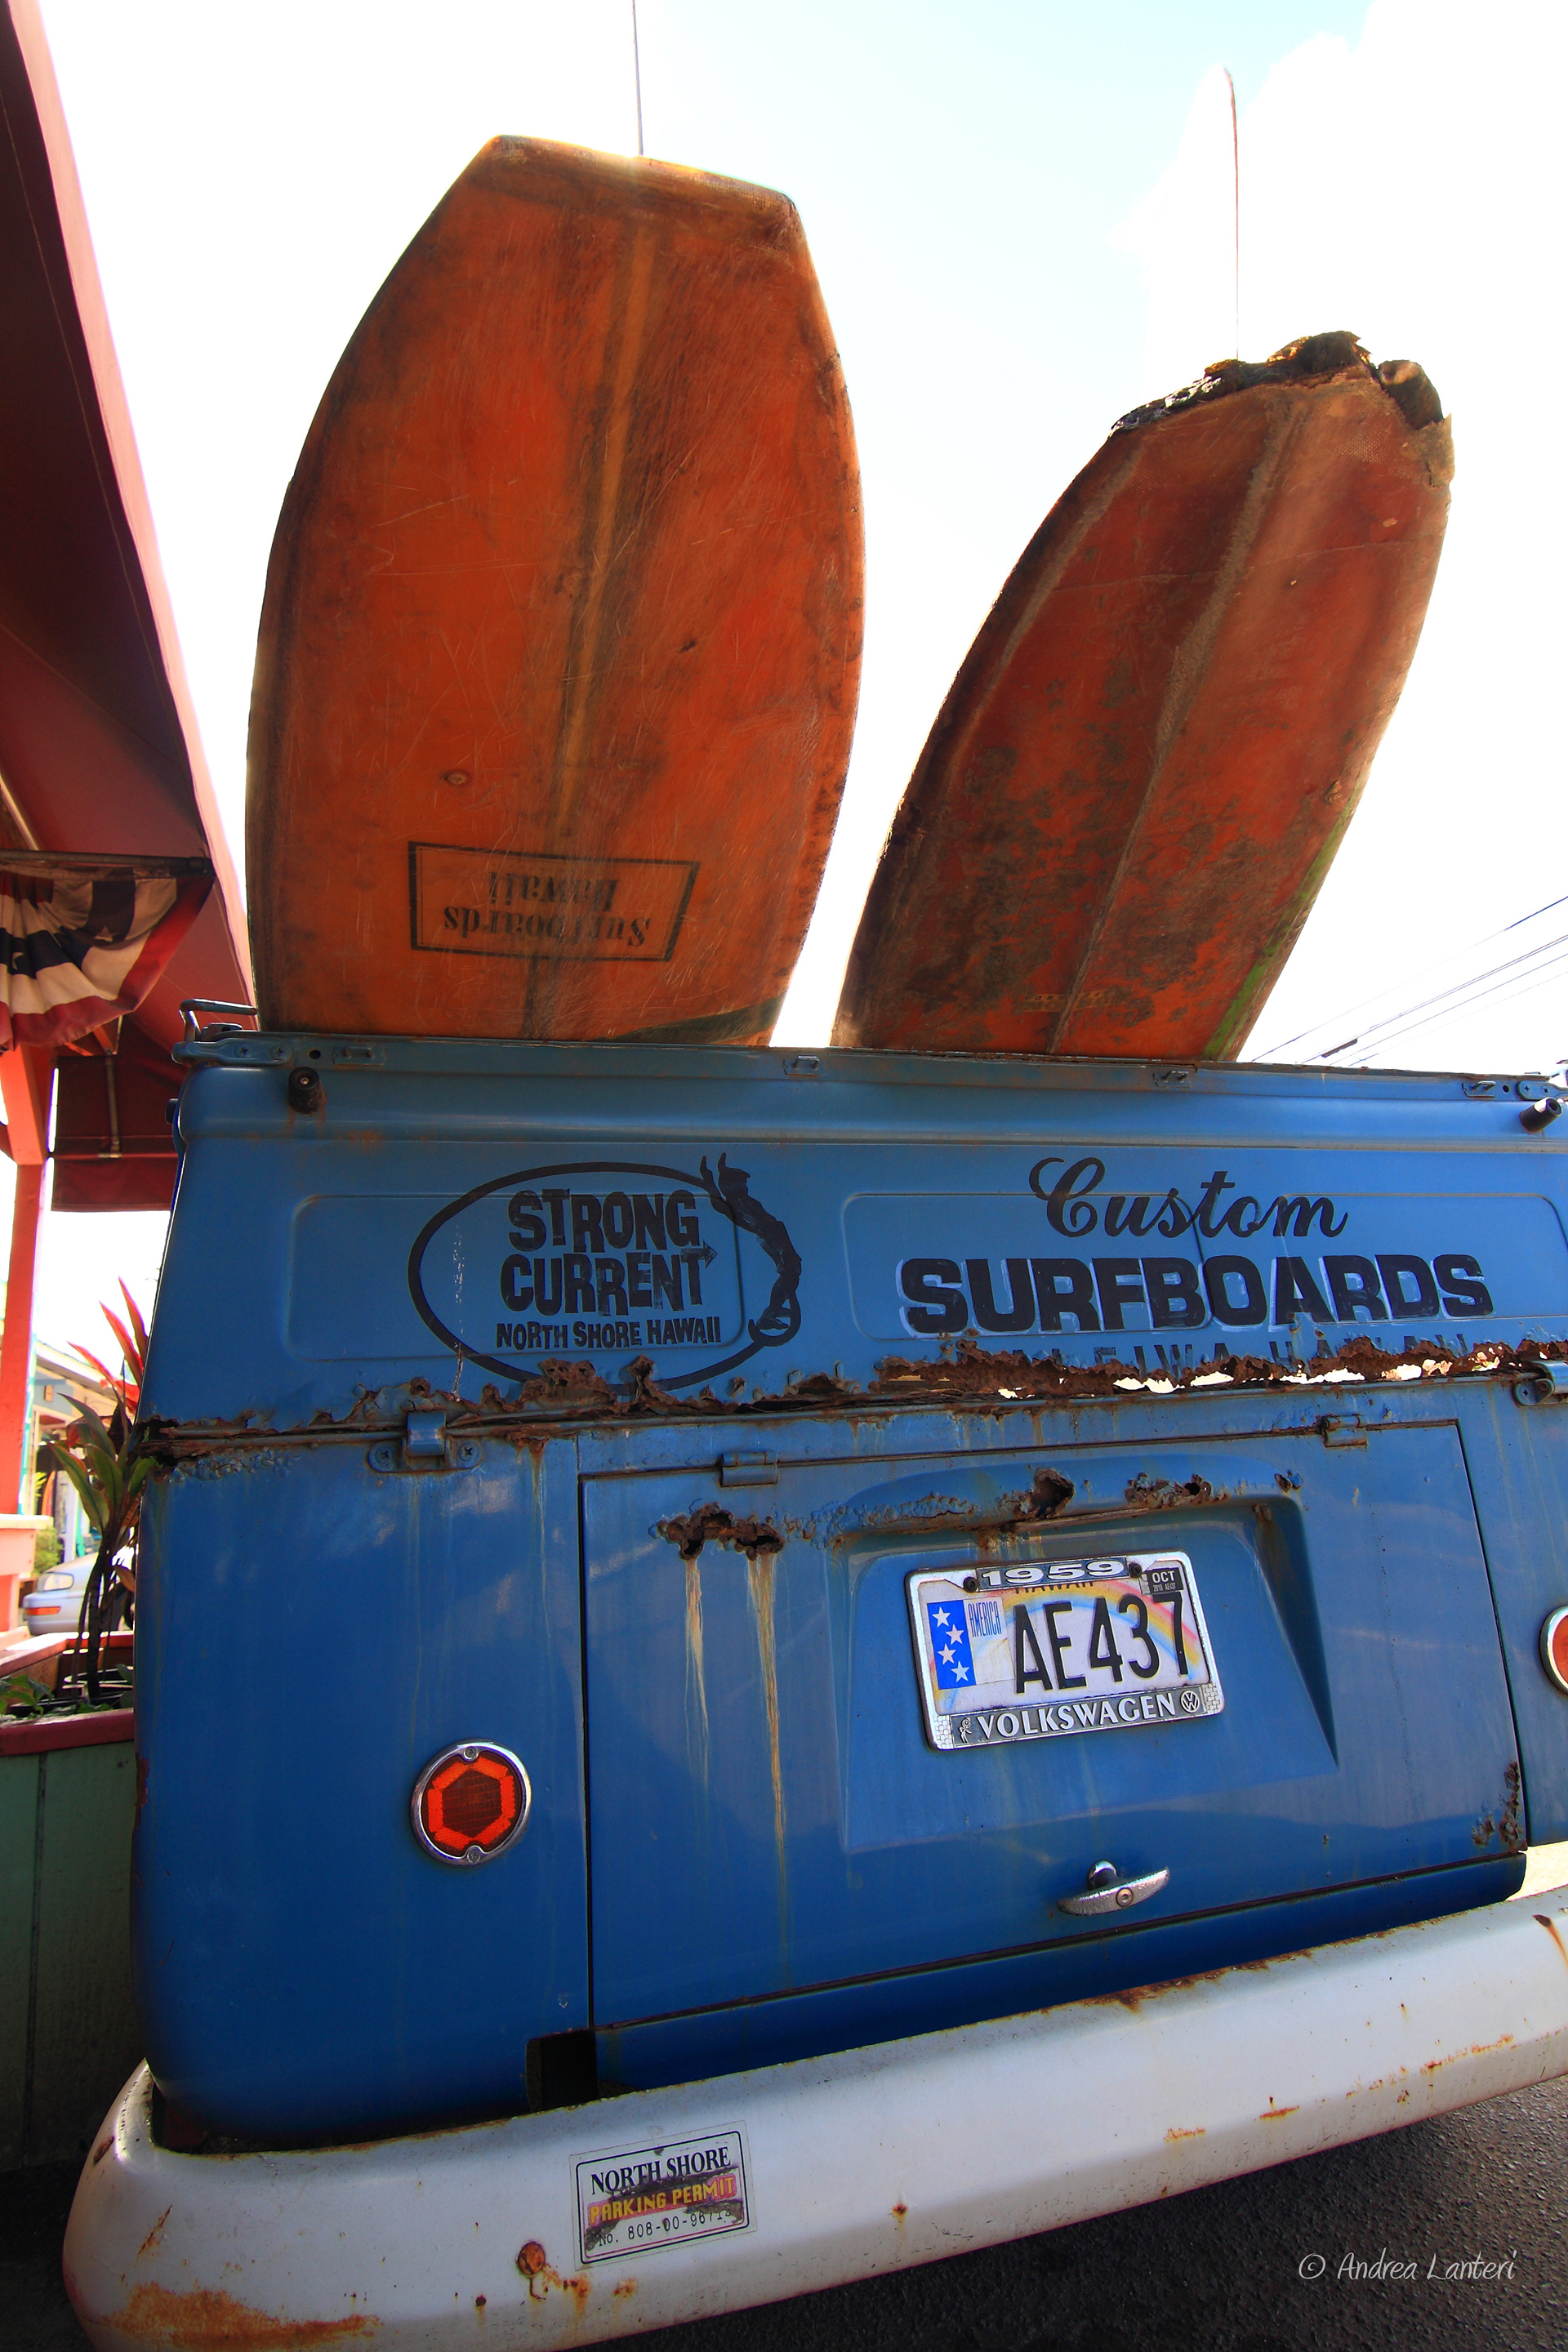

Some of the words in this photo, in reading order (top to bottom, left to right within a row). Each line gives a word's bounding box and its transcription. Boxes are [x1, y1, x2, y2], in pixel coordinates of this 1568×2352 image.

[507, 1188, 701, 1254] STRONG
[1029, 1156, 1349, 1239] Custom
[500, 1243, 718, 1316] CURRENT
[898, 1254, 1494, 1336] SURFBOARDS
[496, 1320, 568, 1350] NORTH
[572, 1320, 642, 1349] SHORE
[646, 1316, 722, 1346] HAWAII
[981, 1560, 1125, 1588] 1959
[1152, 1570, 1175, 1584] OCT
[968, 1601, 1003, 1637] AMERICA
[1013, 1591, 1189, 1694] AE437
[977, 1692, 1176, 1740] VOLKSWAGEN
[590, 2160, 662, 2195] NORTH
[666, 2146, 732, 2179] SHORE
[589, 2192, 666, 2223] PARKING
[672, 2176, 734, 2205] PERMIT
